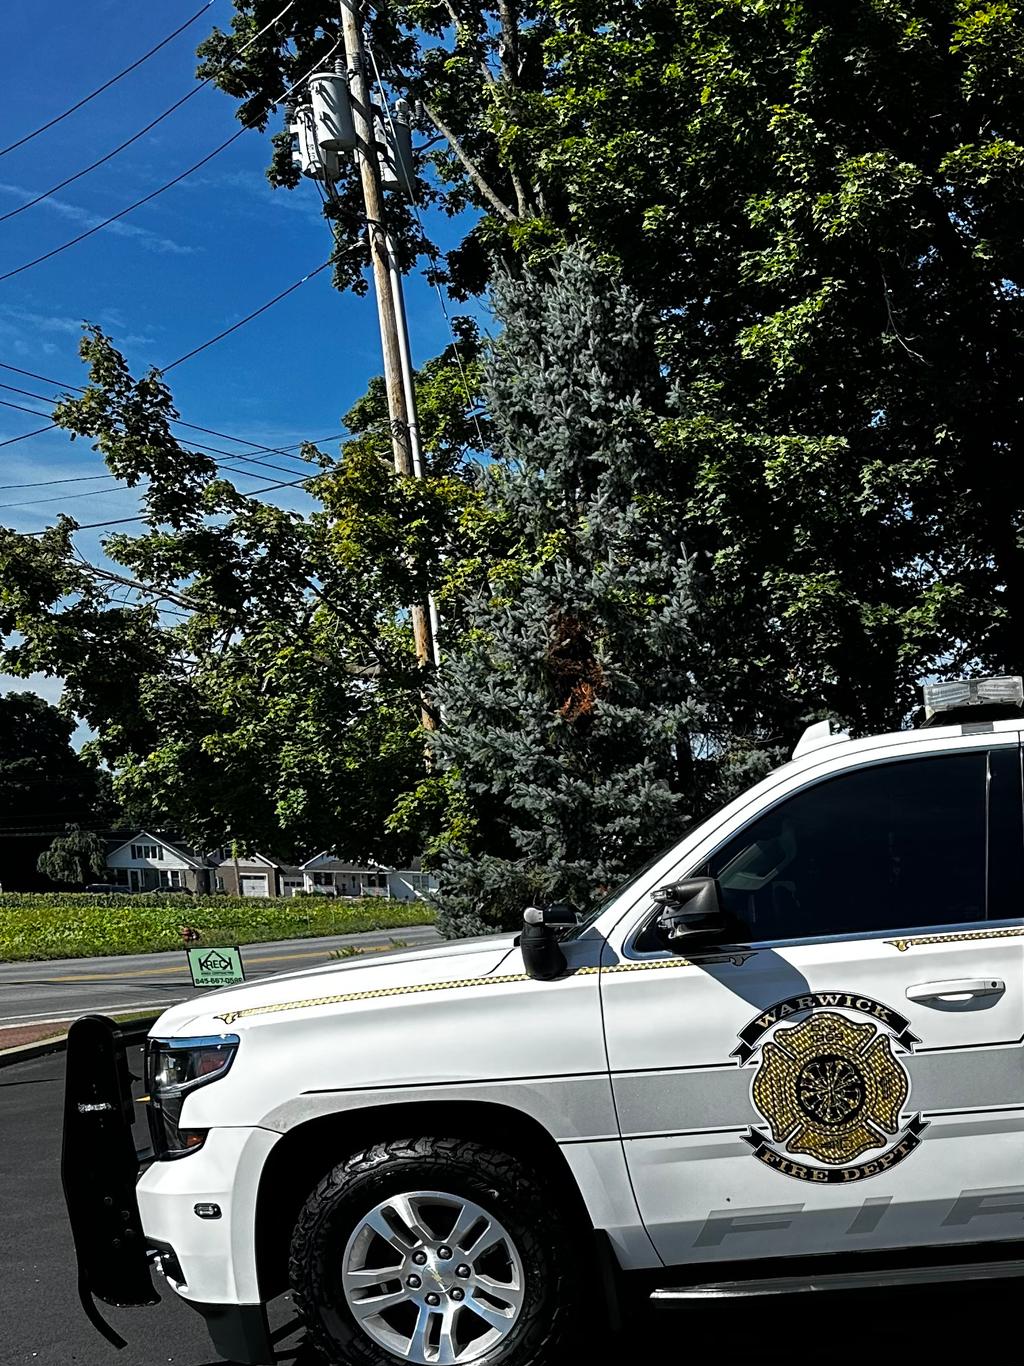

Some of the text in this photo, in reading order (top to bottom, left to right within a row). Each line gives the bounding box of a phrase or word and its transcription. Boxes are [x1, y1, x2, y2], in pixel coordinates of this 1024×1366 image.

[754, 994, 893, 1029] WARWICK
[759, 1139, 917, 1182] FIRE DEPT.
